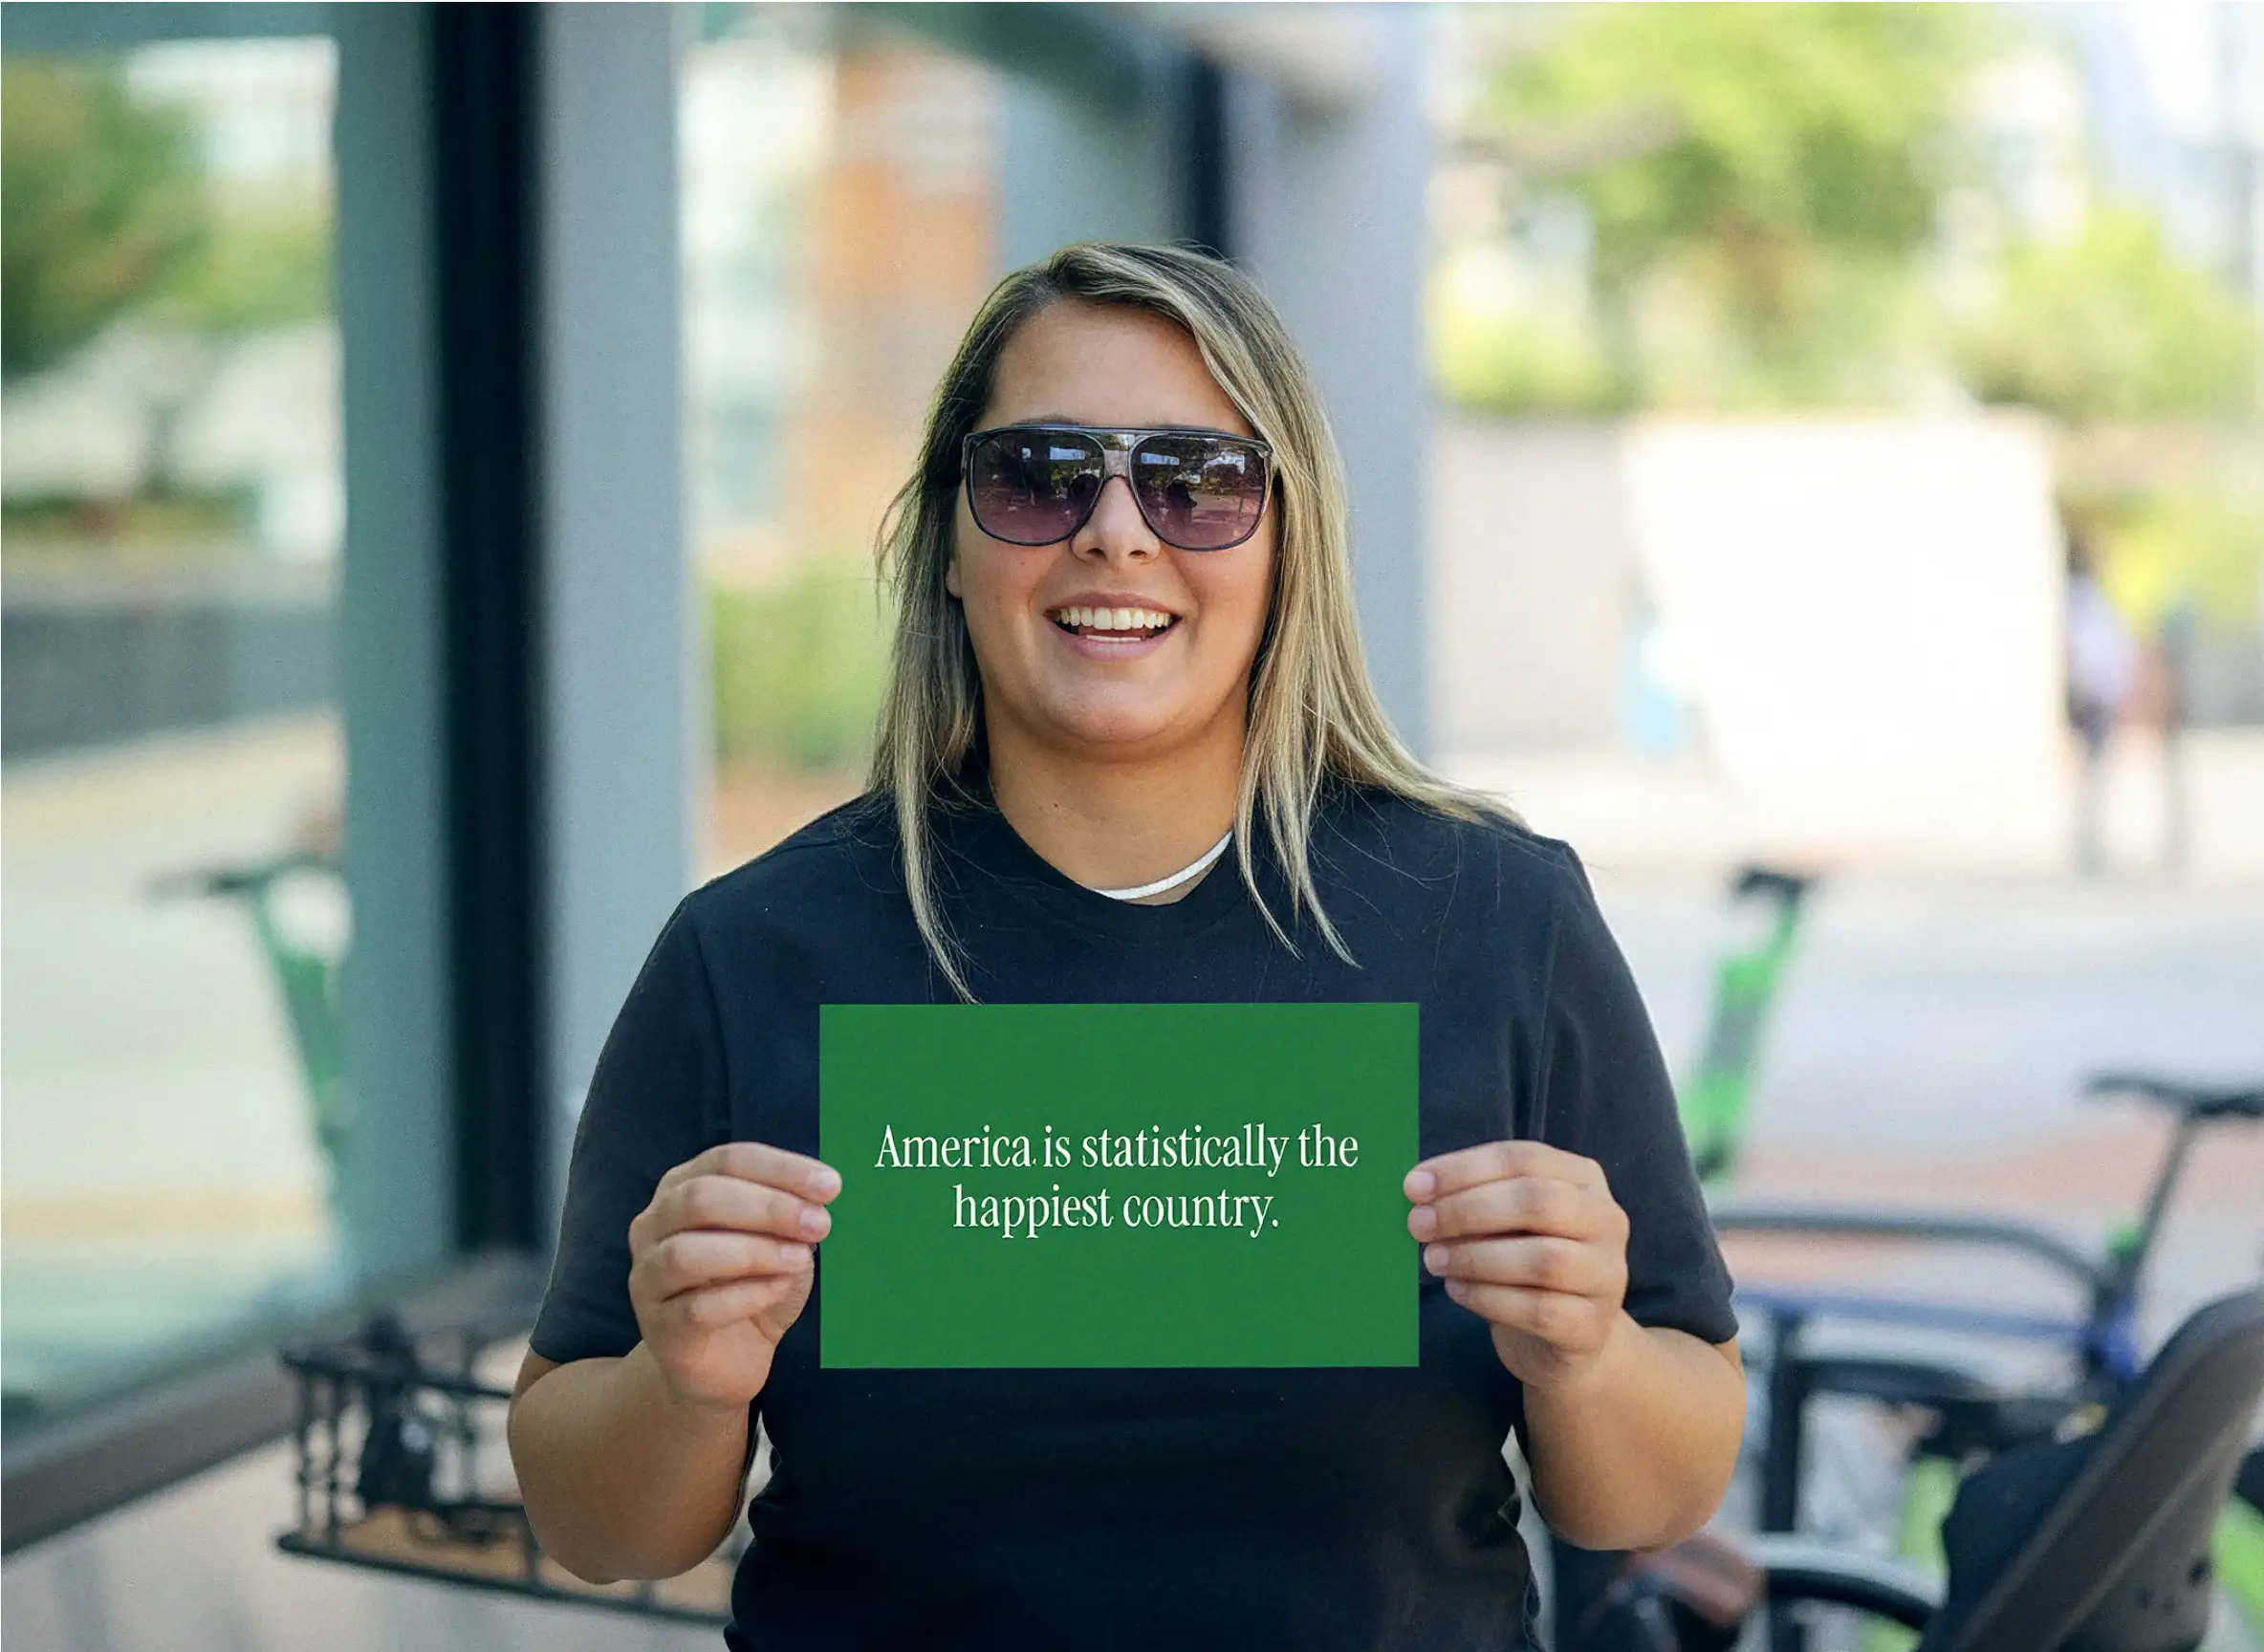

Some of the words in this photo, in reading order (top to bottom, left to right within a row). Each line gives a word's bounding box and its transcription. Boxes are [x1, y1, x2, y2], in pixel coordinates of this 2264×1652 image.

[874, 1124, 1031, 1168] America
[1043, 1124, 1072, 1168] is
[1081, 1122, 1291, 1178] statistically
[1297, 1123, 1359, 1168] the
[952, 1184, 1114, 1239] happiest
[1122, 1188, 1279, 1239] country.
